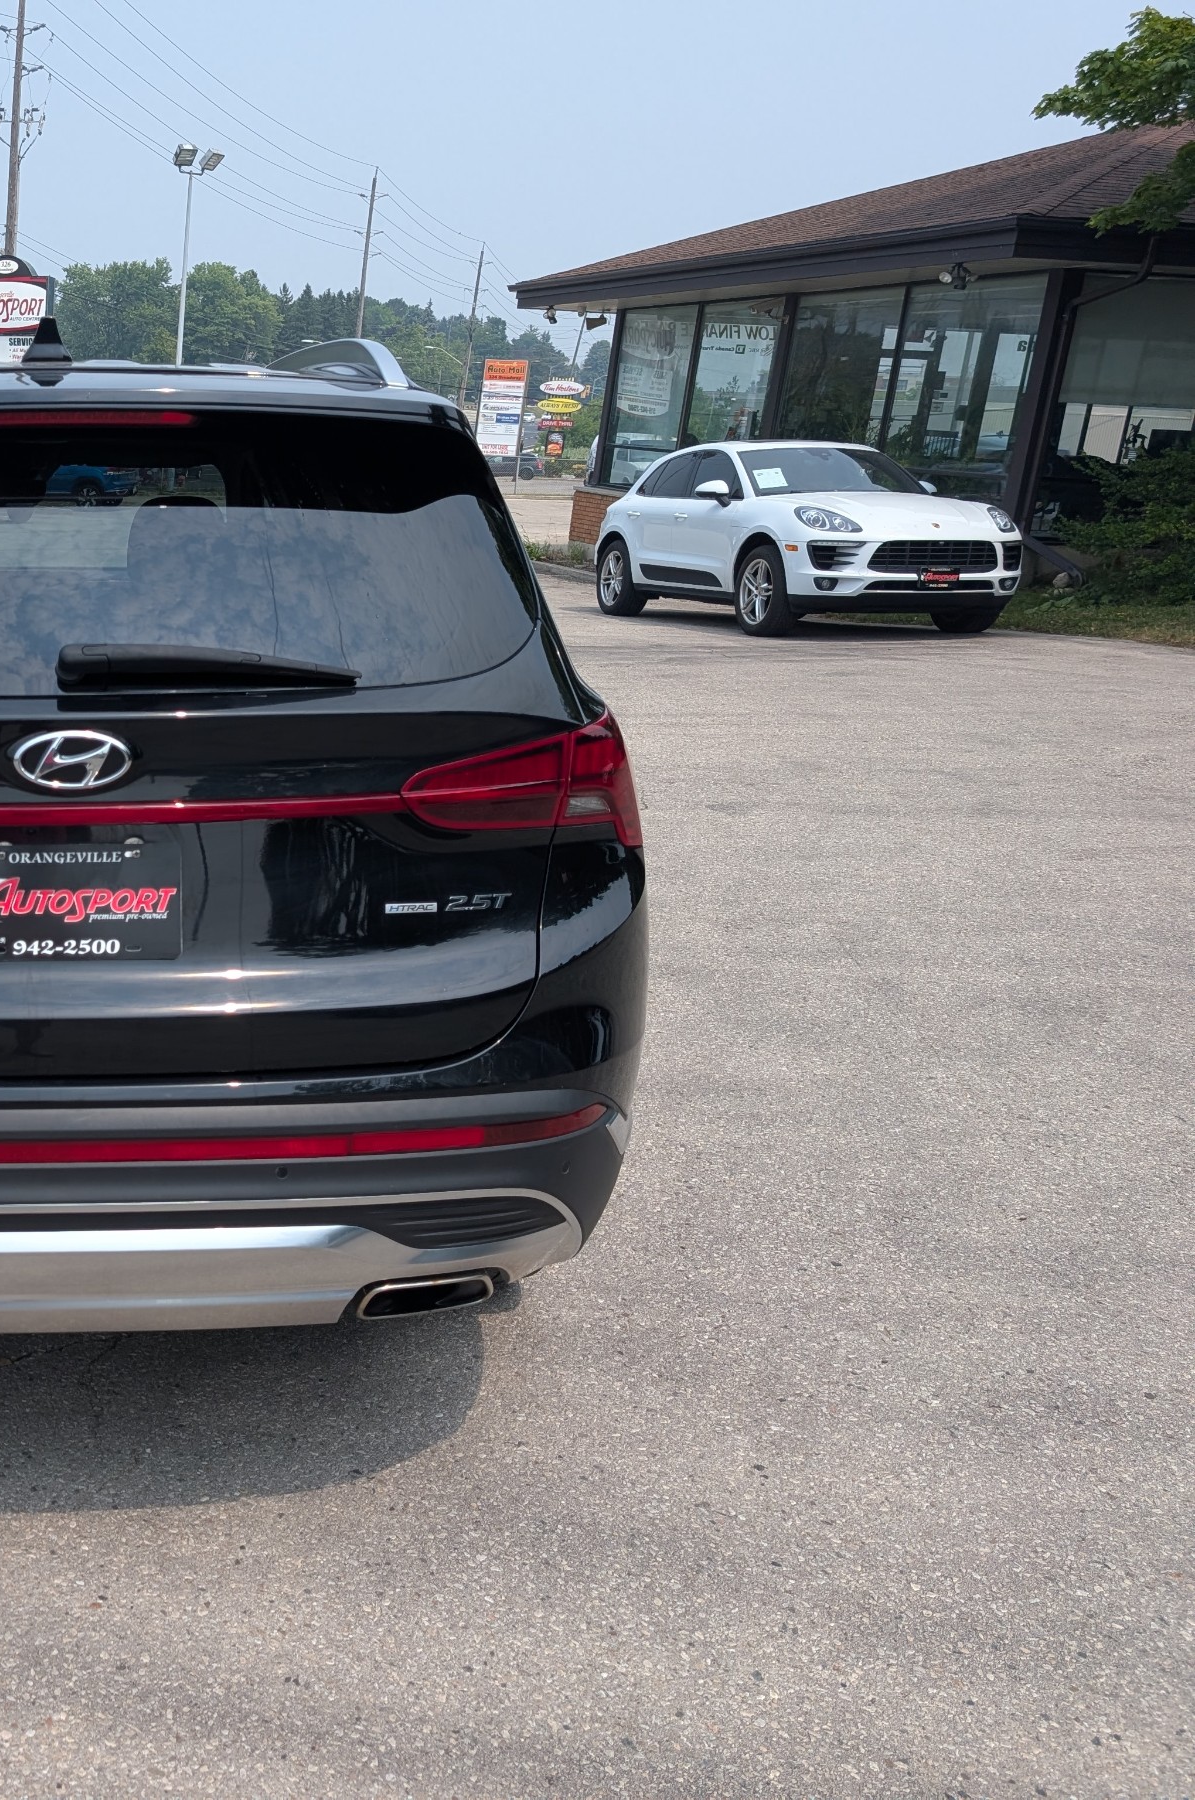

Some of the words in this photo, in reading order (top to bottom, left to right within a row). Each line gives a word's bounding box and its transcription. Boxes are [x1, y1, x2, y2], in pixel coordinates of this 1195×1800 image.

[8, 337, 33, 346] SERVIC
[488, 365, 505, 373] Auto
[509, 366, 524, 374] Mall
[555, 384, 579, 392] Hortons
[8, 851, 122, 864] ORANGEVILLE
[389, 904, 434, 912] HTRAC
[89, 912, 124, 922] premium
[126, 911, 168, 922] pre-owned
[12, 939, 120, 955] 942-2500
